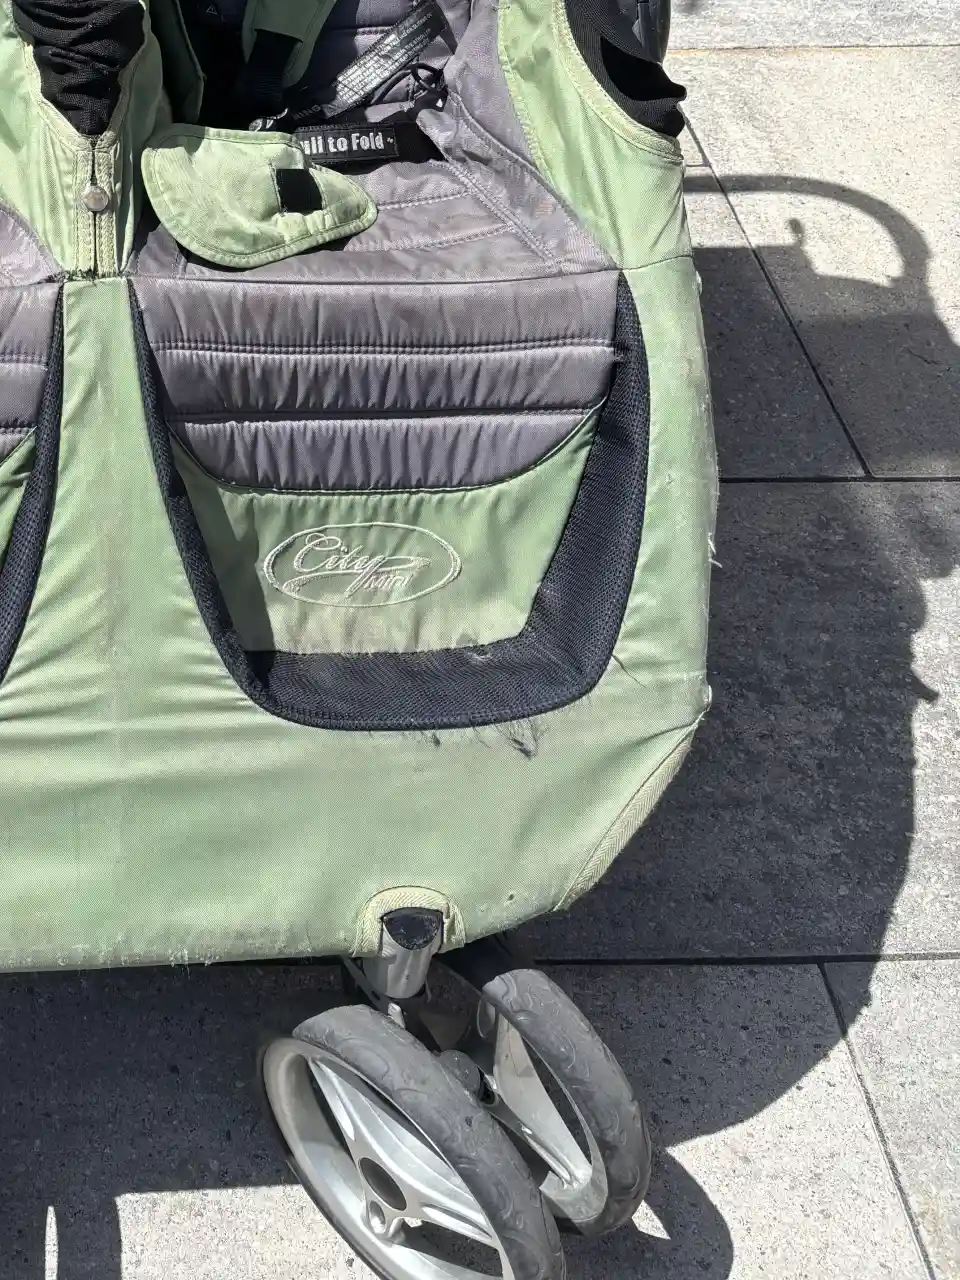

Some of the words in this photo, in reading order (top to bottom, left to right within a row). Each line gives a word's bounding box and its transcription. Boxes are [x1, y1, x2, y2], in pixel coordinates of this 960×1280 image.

[300, 135, 324, 155] ull
[327, 136, 348, 153] to
[351, 131, 385, 151] Fold
[294, 532, 408, 599] City
